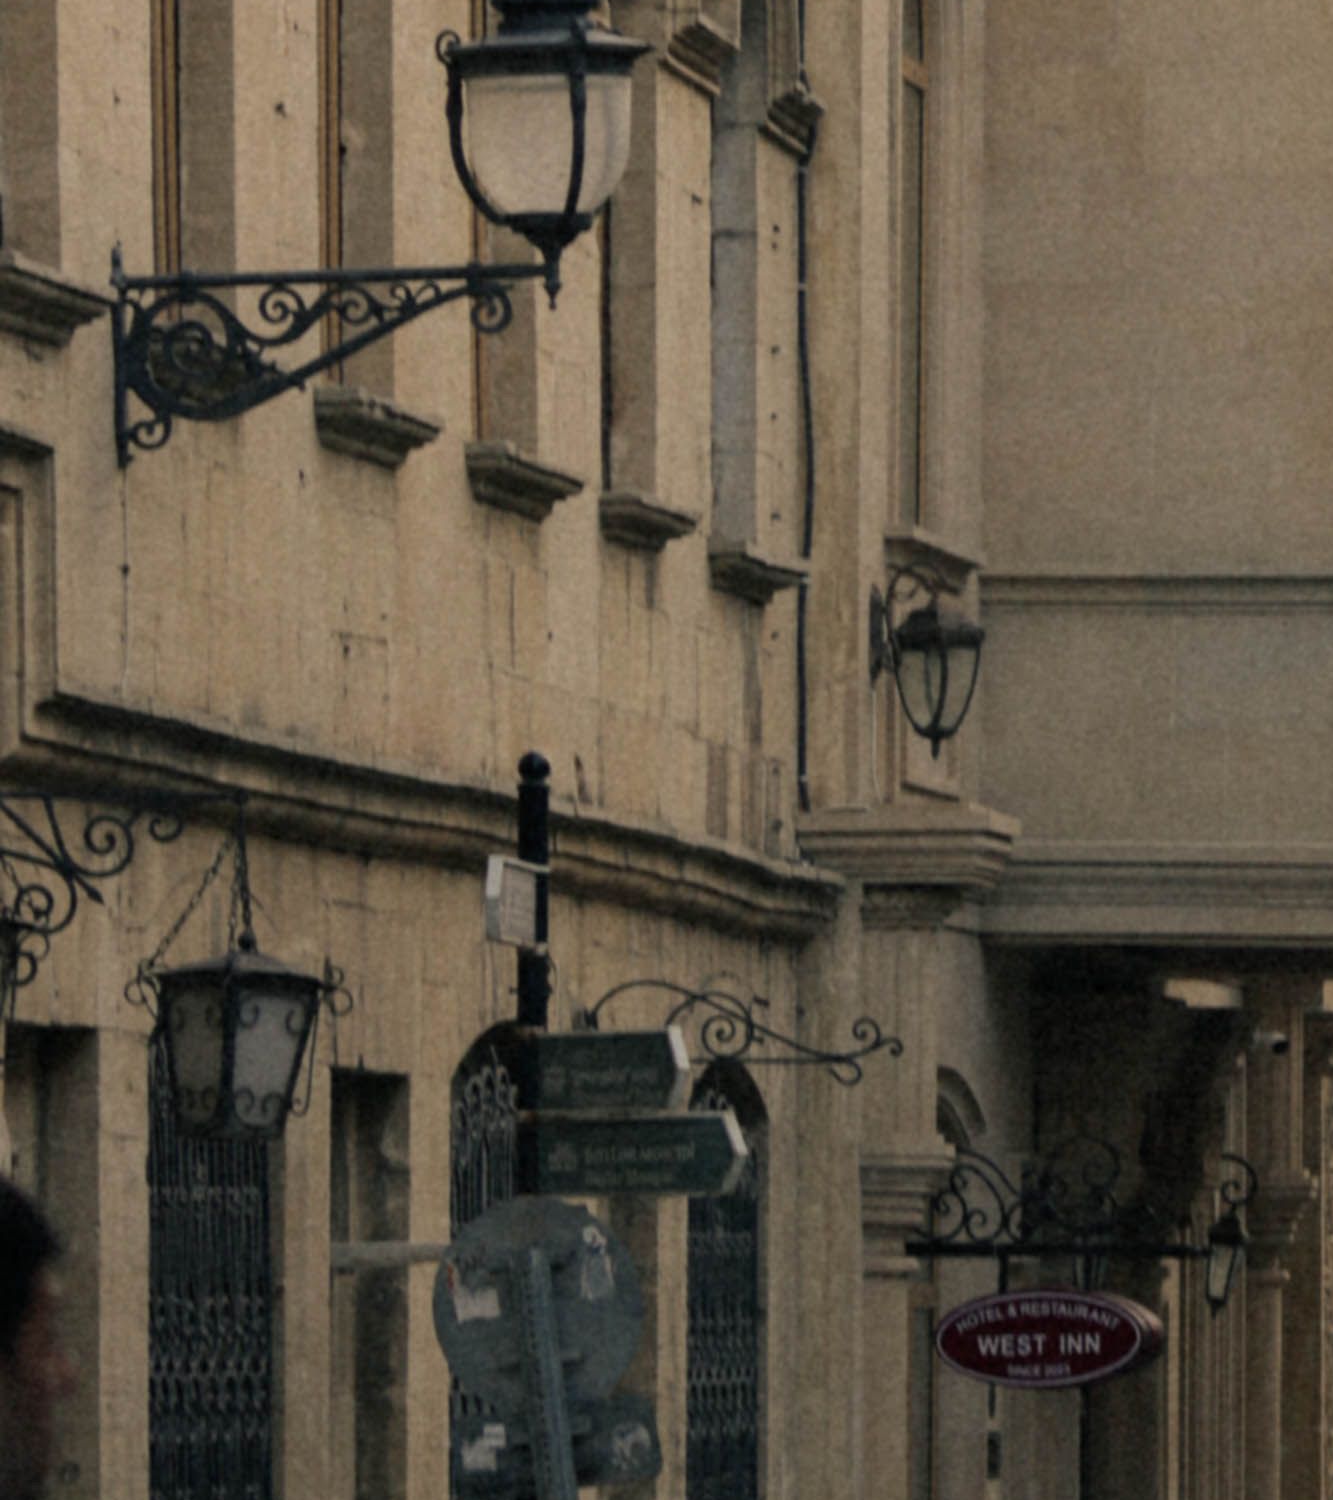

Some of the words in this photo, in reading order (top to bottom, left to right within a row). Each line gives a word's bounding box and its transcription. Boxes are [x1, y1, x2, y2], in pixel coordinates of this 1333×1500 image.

[956, 1308, 1004, 1333] HOTEL
[1020, 1302, 1119, 1330] RESTAURANT
[977, 1334, 1046, 1357] WEST
[1060, 1332, 1101, 1355] INN
